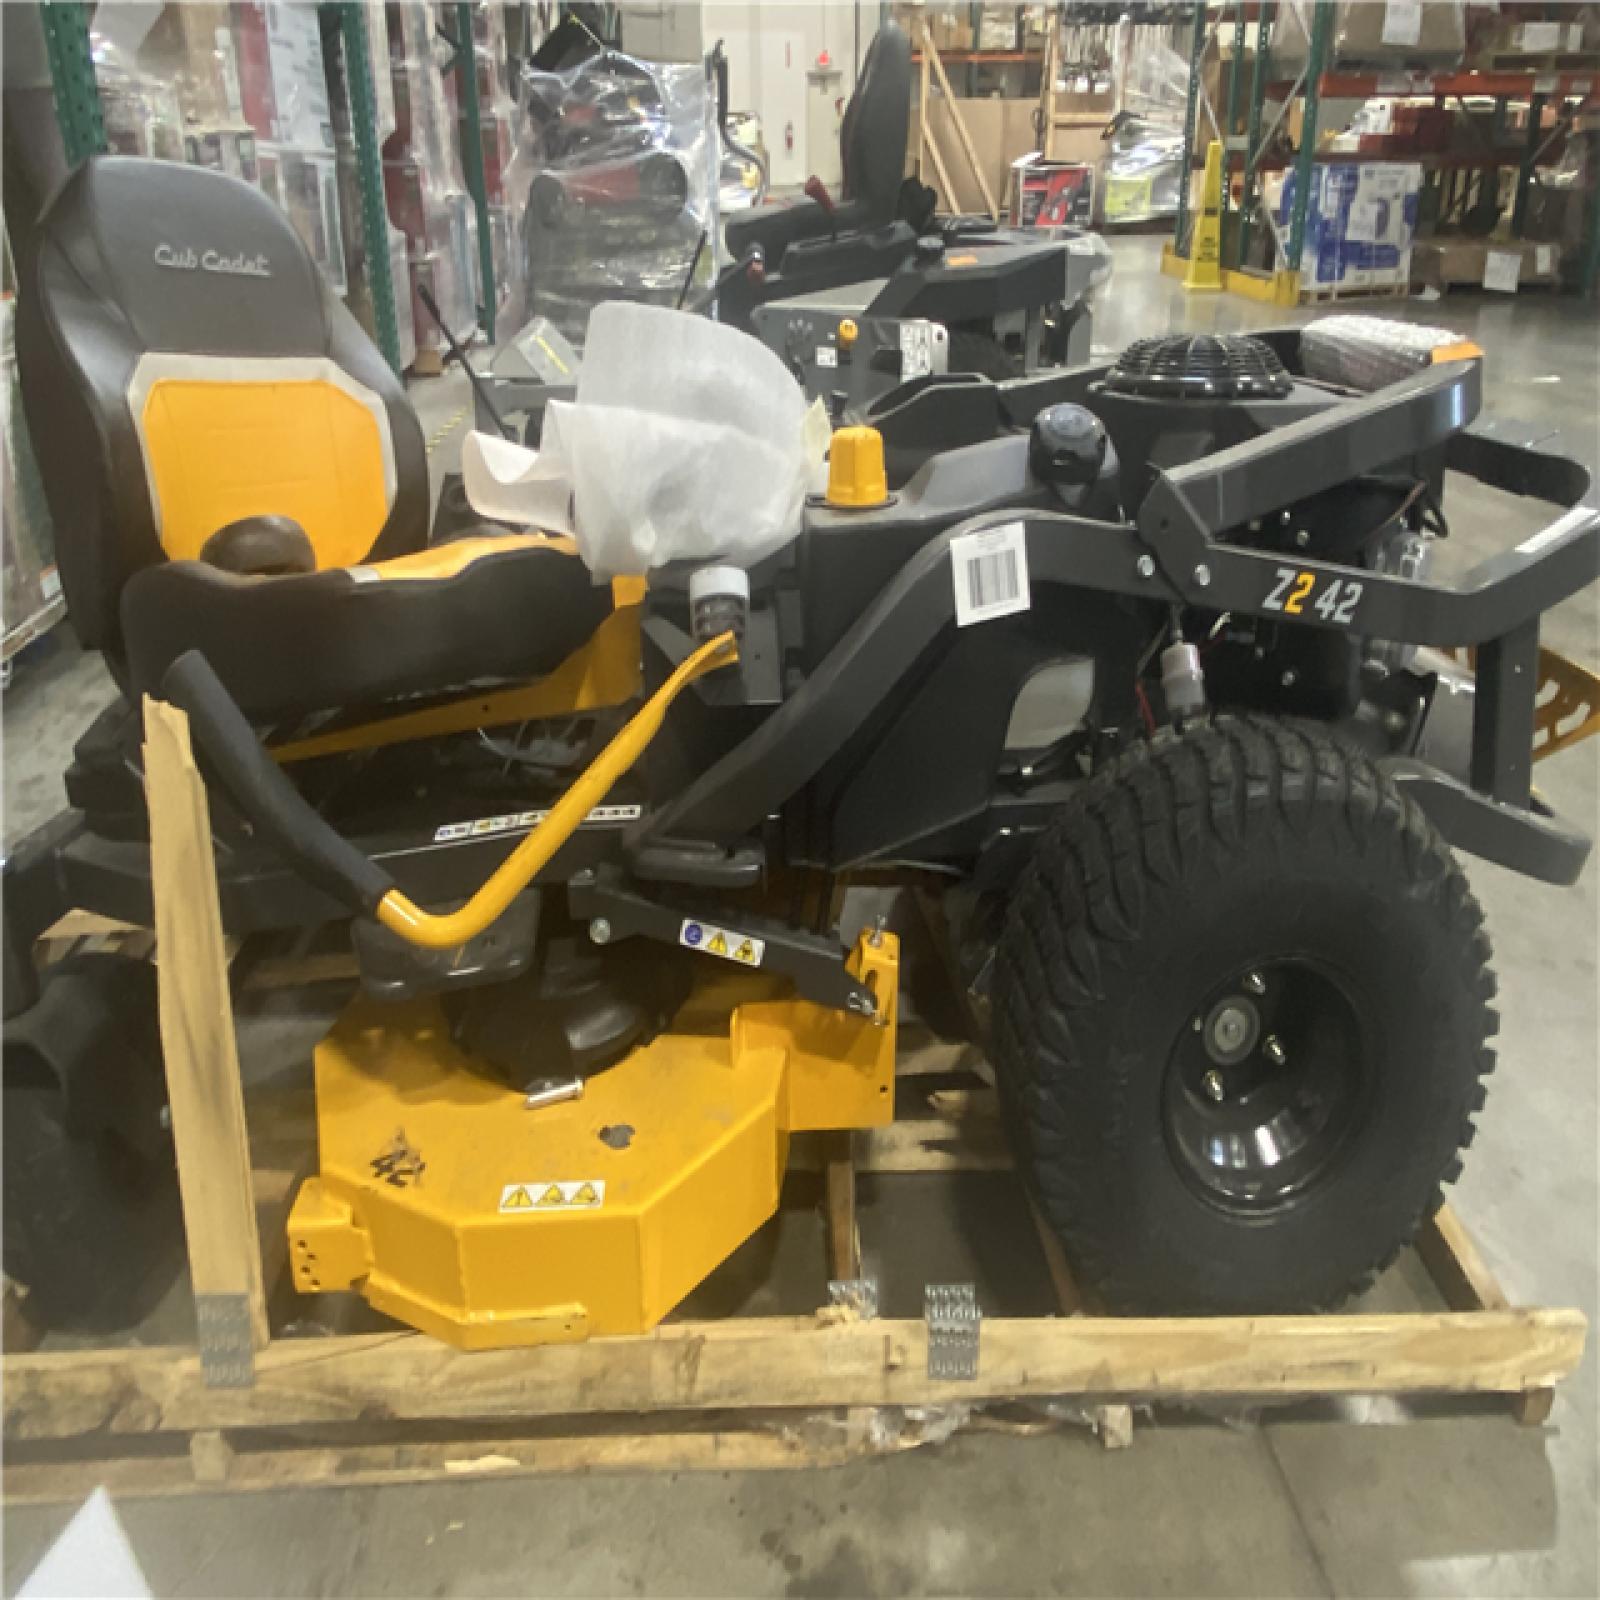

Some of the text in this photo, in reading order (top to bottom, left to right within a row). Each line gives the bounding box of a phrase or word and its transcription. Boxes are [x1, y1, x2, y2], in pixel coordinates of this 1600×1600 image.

[154, 244, 271, 276] Cub Cadet
[1262, 568, 1363, 623] Z2 42
